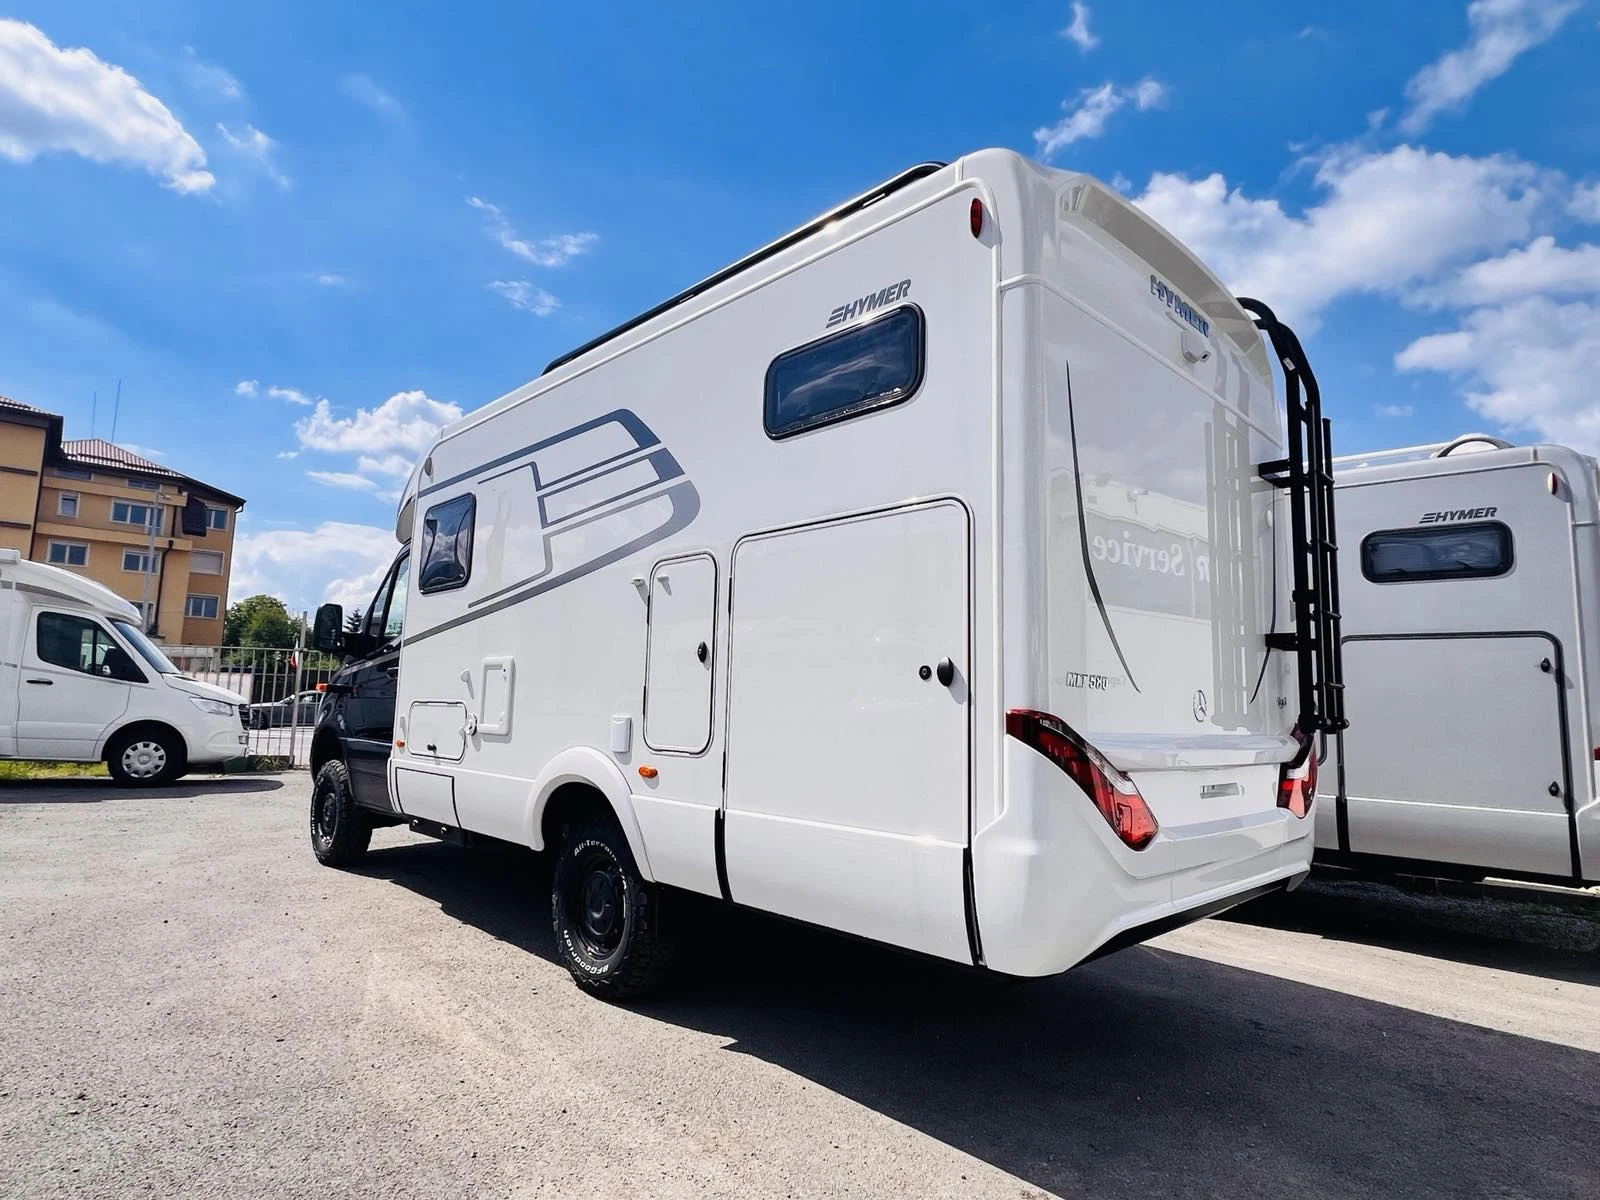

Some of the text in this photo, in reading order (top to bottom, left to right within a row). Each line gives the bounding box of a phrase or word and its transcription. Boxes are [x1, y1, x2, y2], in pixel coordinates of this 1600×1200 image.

[840, 279, 912, 322] HYMER
[1150, 274, 1209, 338] HYMER
[1433, 506, 1498, 522] HYMER
[1088, 674, 1108, 692] 580
